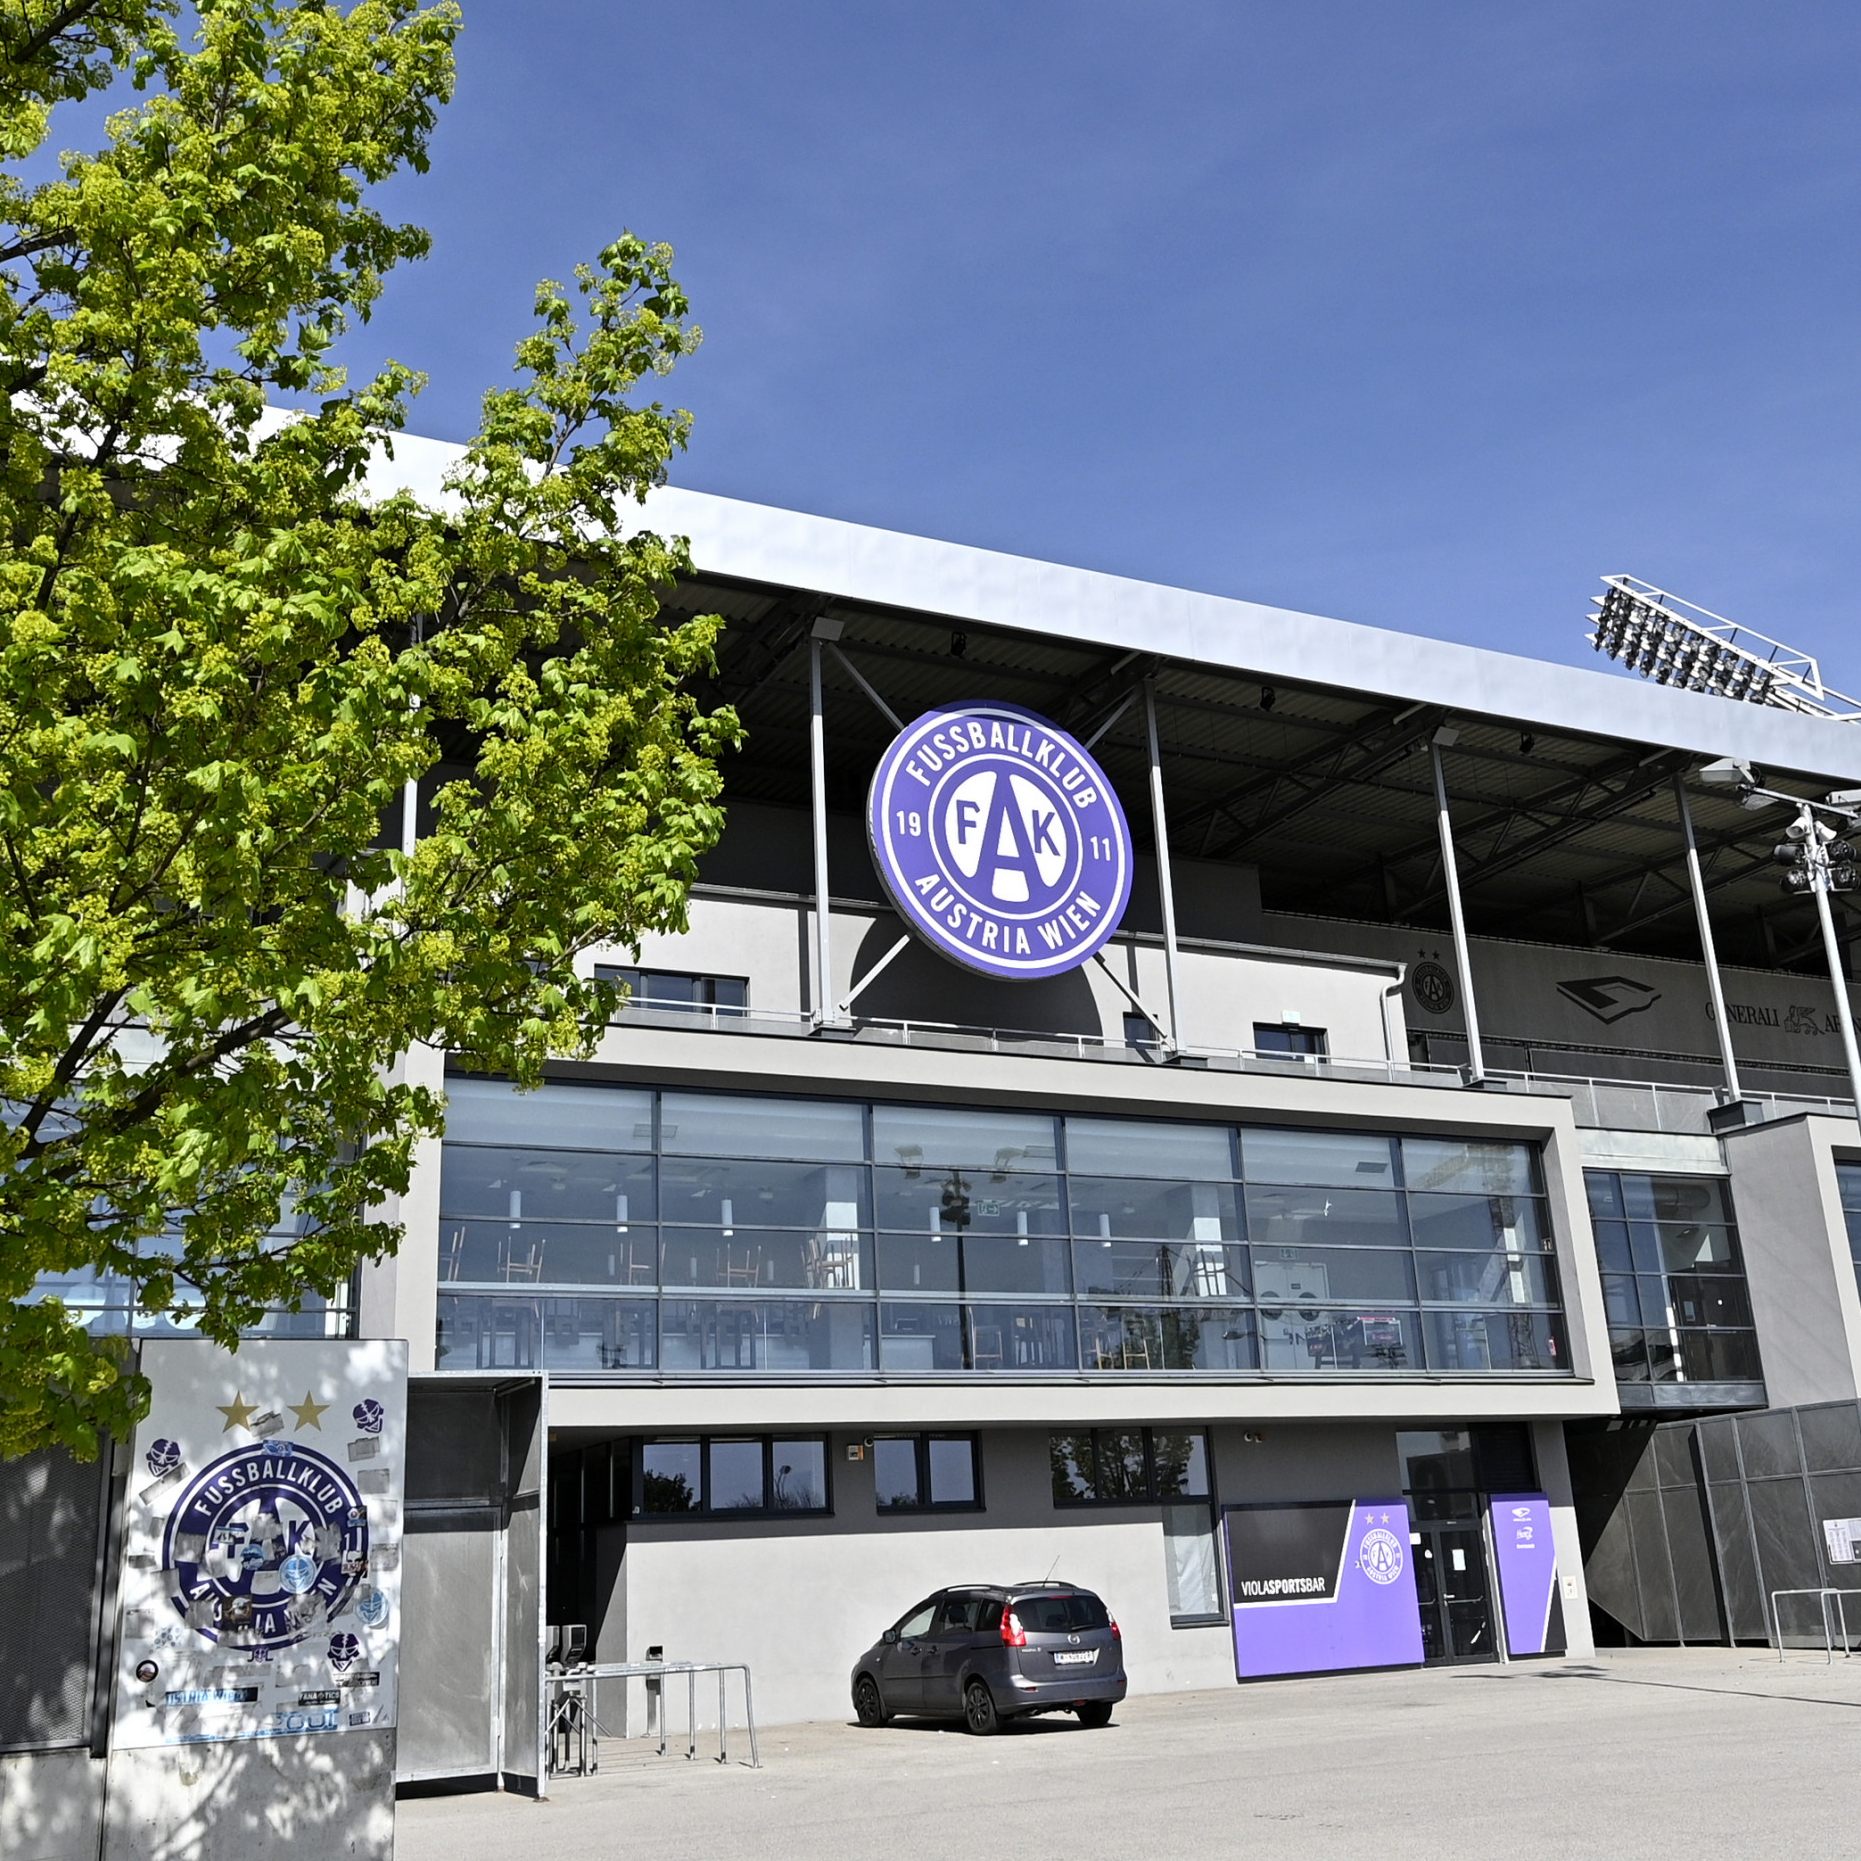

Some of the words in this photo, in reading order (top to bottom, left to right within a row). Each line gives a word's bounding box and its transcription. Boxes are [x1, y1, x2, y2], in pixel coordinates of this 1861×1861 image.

[905, 721, 1098, 809] FUSSBALLKLUB
[896, 810, 922, 837] 19
[955, 770, 1061, 902] FAK
[1090, 836, 1112, 862] 11
[915, 873, 1032, 955] AUSTRIA
[1037, 890, 1101, 951] WIEN
[1705, 1001, 1780, 1027] GNERALI
[194, 1459, 344, 1517] FUSSBALLKLUB
[1241, 1577, 1326, 1596] VIOLASPORTSBAR
